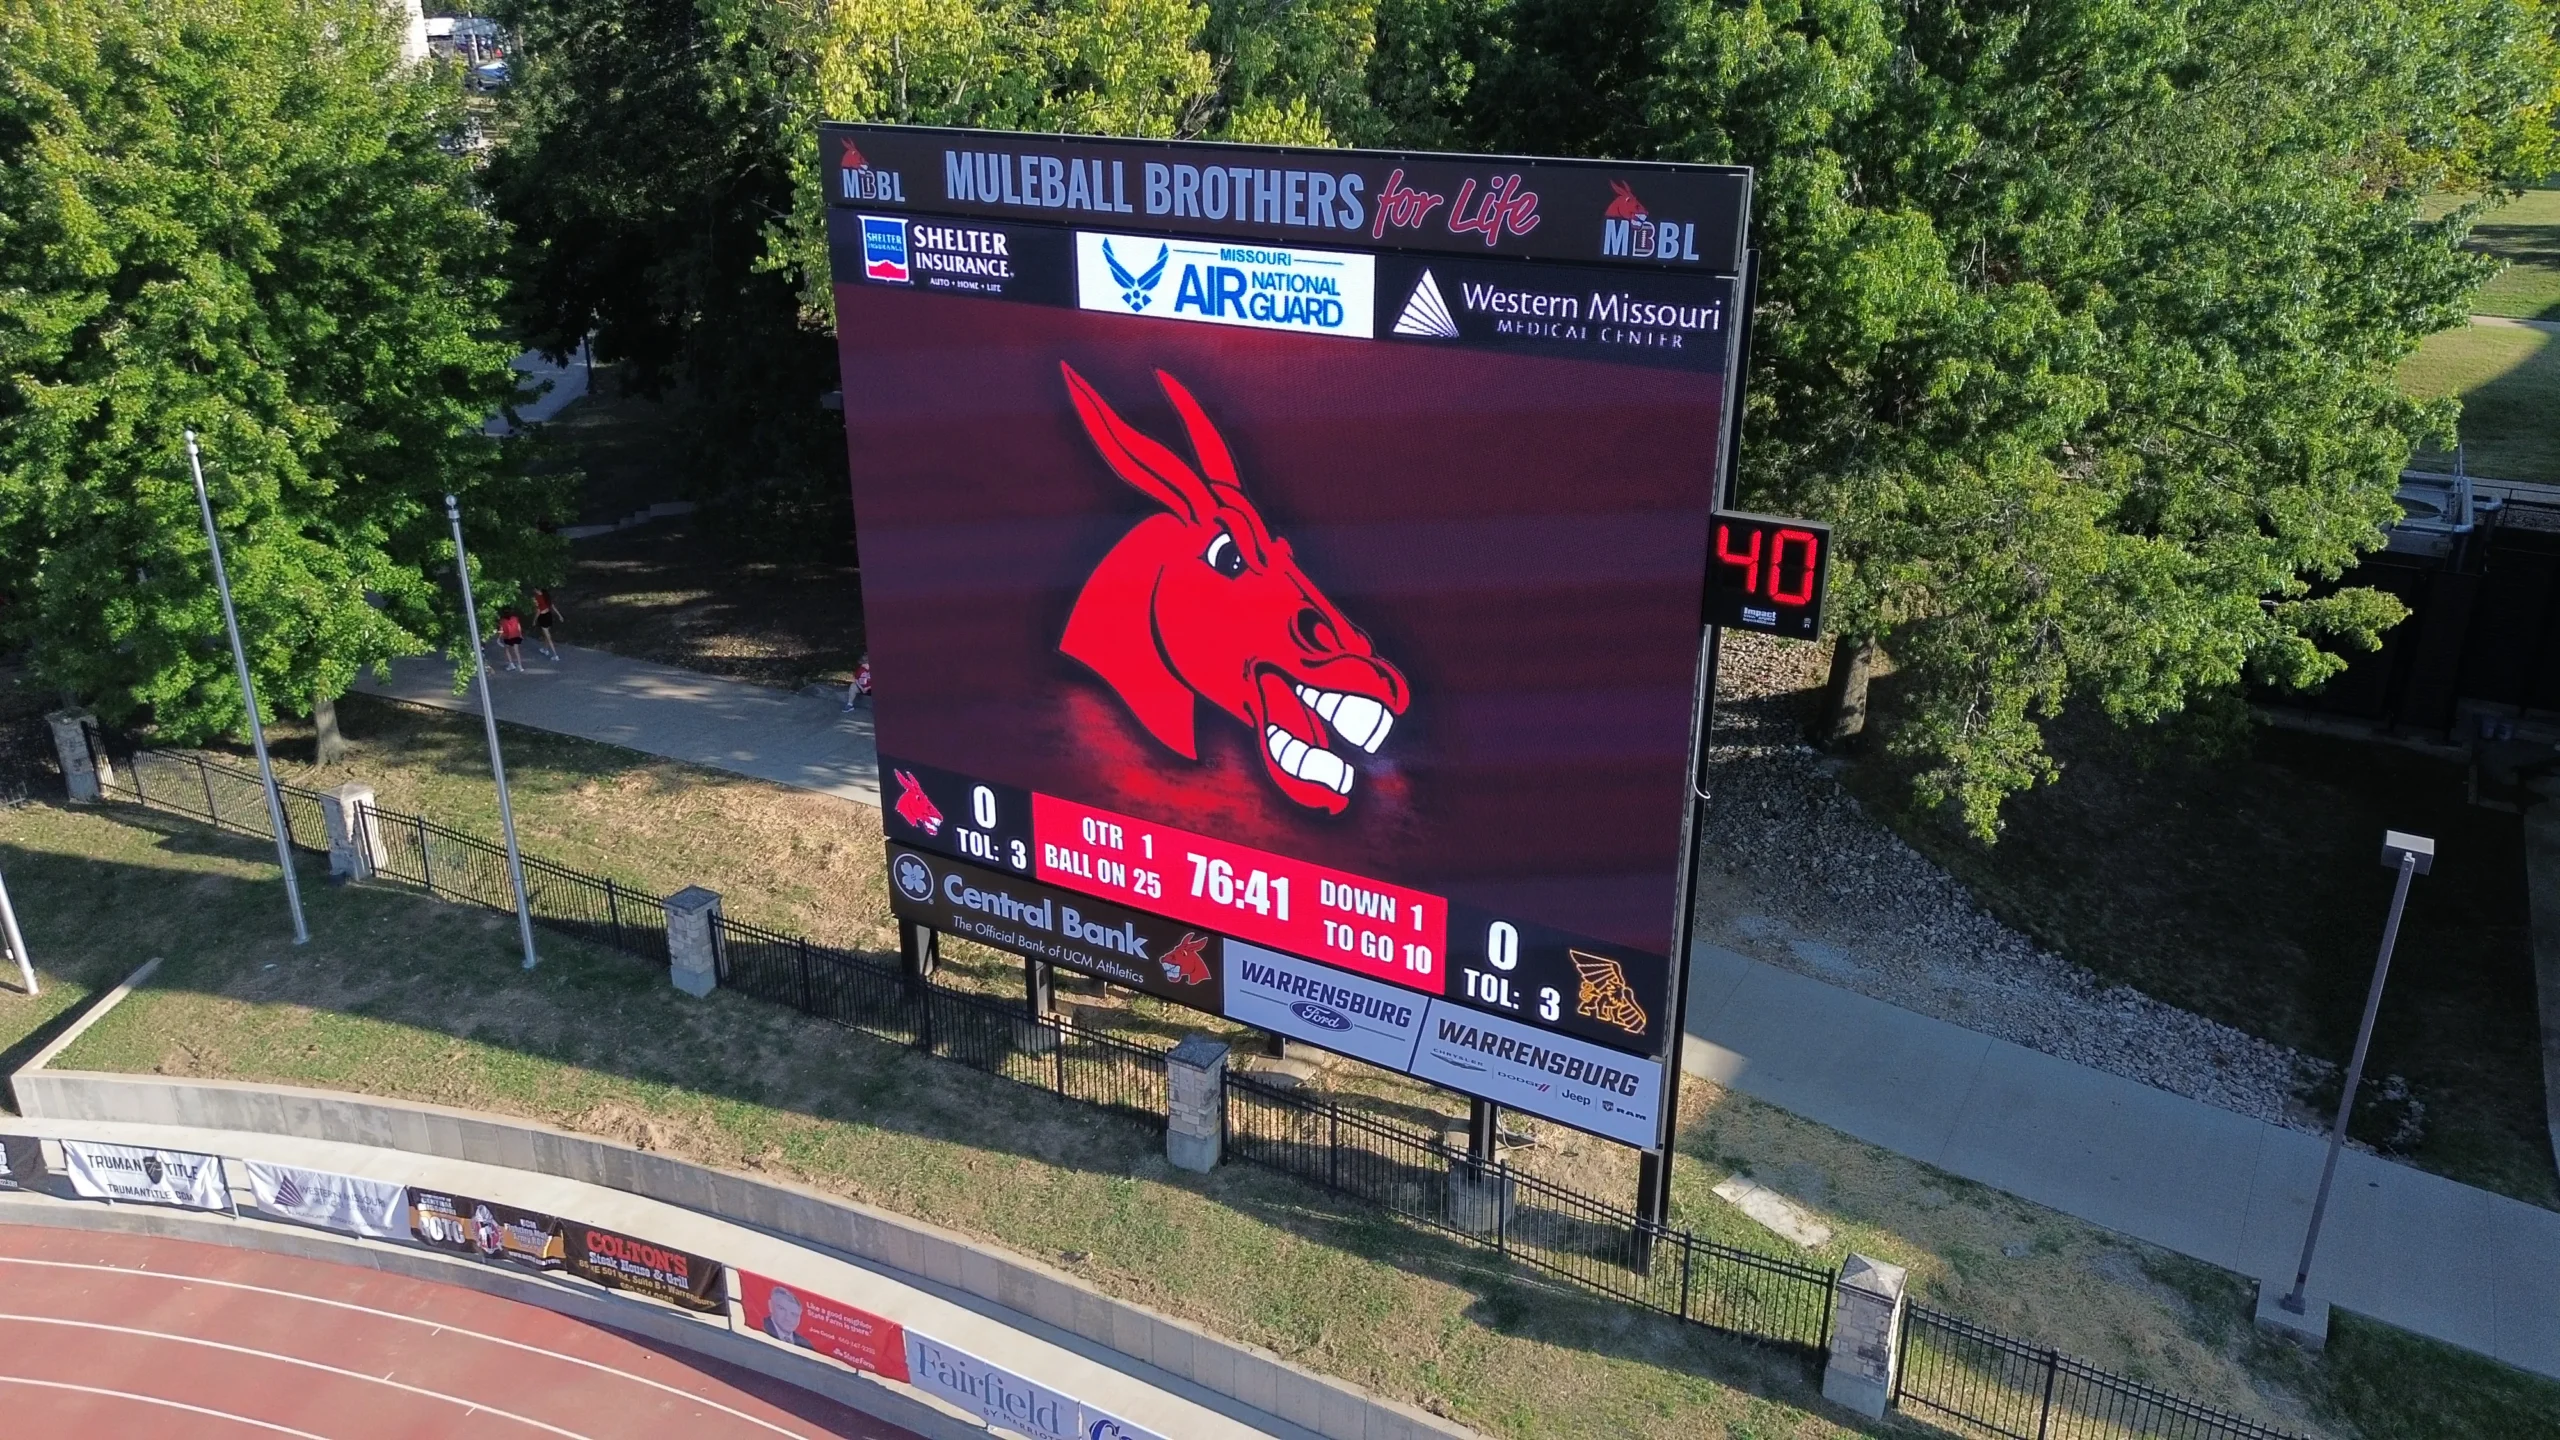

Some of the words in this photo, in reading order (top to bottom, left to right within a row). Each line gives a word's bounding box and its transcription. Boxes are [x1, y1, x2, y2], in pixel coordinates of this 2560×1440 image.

[945, 150, 1133, 213] MULEBALL
[1144, 161, 1364, 230] BROTHERS
[1372, 168, 1444, 240] for
[1448, 174, 1540, 246] Life
[866, 232, 902, 245] SHELTER
[913, 224, 1009, 256] SHELTER
[1220, 248, 1291, 266] MISSOURI
[915, 251, 1010, 278] INSURANCE
[930, 277, 950, 287] AUTO
[957, 280, 979, 290] HOME
[986, 283, 1002, 293] LIFE
[1251, 270, 1341, 296] NATIONAL
[1174, 263, 1248, 320] AIR
[1249, 292, 1344, 328] GUARD
[1462, 281, 1579, 319] Western
[1588, 291, 1721, 332] Missouri
[1496, 319, 1588, 340] MEDICAL
[1600, 327, 1683, 349] CENTER
[1716, 525, 1818, 605] 40
[1743, 607, 1777, 619] Impact
[972, 785, 998, 830] 0
[956, 826, 1000, 863] TOL:
[1010, 839, 1028, 871] 3
[1082, 816, 1124, 851] QTR
[1140, 833, 1153, 859] 1
[1044, 843, 1093, 880] BALL
[1097, 857, 1126, 889] ON
[1132, 868, 1162, 899] 25
[1186, 852, 1291, 922] 76:41
[943, 873, 1054, 932] Central
[1061, 905, 1150, 961] Bank
[1319, 879, 1397, 923] DOWN
[1409, 904, 1424, 932] 1
[953, 914, 973, 932] The
[975, 920, 1015, 946] Official
[1018, 934, 1046, 955] Bank
[1048, 942, 1062, 959] of
[1063, 947, 1094, 968] UCM
[1095, 957, 1145, 984] Athletics
[1322, 919, 1355, 951] TO
[1361, 933, 1395, 963] GO
[1401, 943, 1433, 976] 10
[1487, 920, 1521, 972] 0
[1240, 958, 1412, 1029] WARRENSBURG
[1463, 967, 1521, 1011] TOL:
[1538, 986, 1562, 1023] 3
[1302, 1004, 1341, 1029] Ford
[1432, 1047, 1485, 1067] CHRYSLER
[1437, 1018, 1640, 1098] WARRENSBURG
[1561, 1088, 1592, 1106] Jeep
[1616, 1107, 1648, 1121] RAM
[87, 1154, 142, 1172] TRUMAN
[164, 1162, 199, 1180] TITLE
[586, 1230, 689, 1277] COLTON'S
[588, 1251, 618, 1268] Steak
[620, 1258, 651, 1278] House
[652, 1269, 664, 1282] &
[666, 1273, 690, 1290] Grill
[602, 1266, 617, 1277] 501
[632, 1275, 654, 1287] Suite
[654, 1280, 662, 1290] B
[806, 1301, 820, 1312] Like
[826, 1310, 843, 1320] good
[807, 1309, 825, 1321] State
[825, 1316, 843, 1328] Farm
[844, 1321, 850, 1330] is
[916, 1341, 1062, 1436] Fairfield
[983, 1406, 998, 1418] BY
